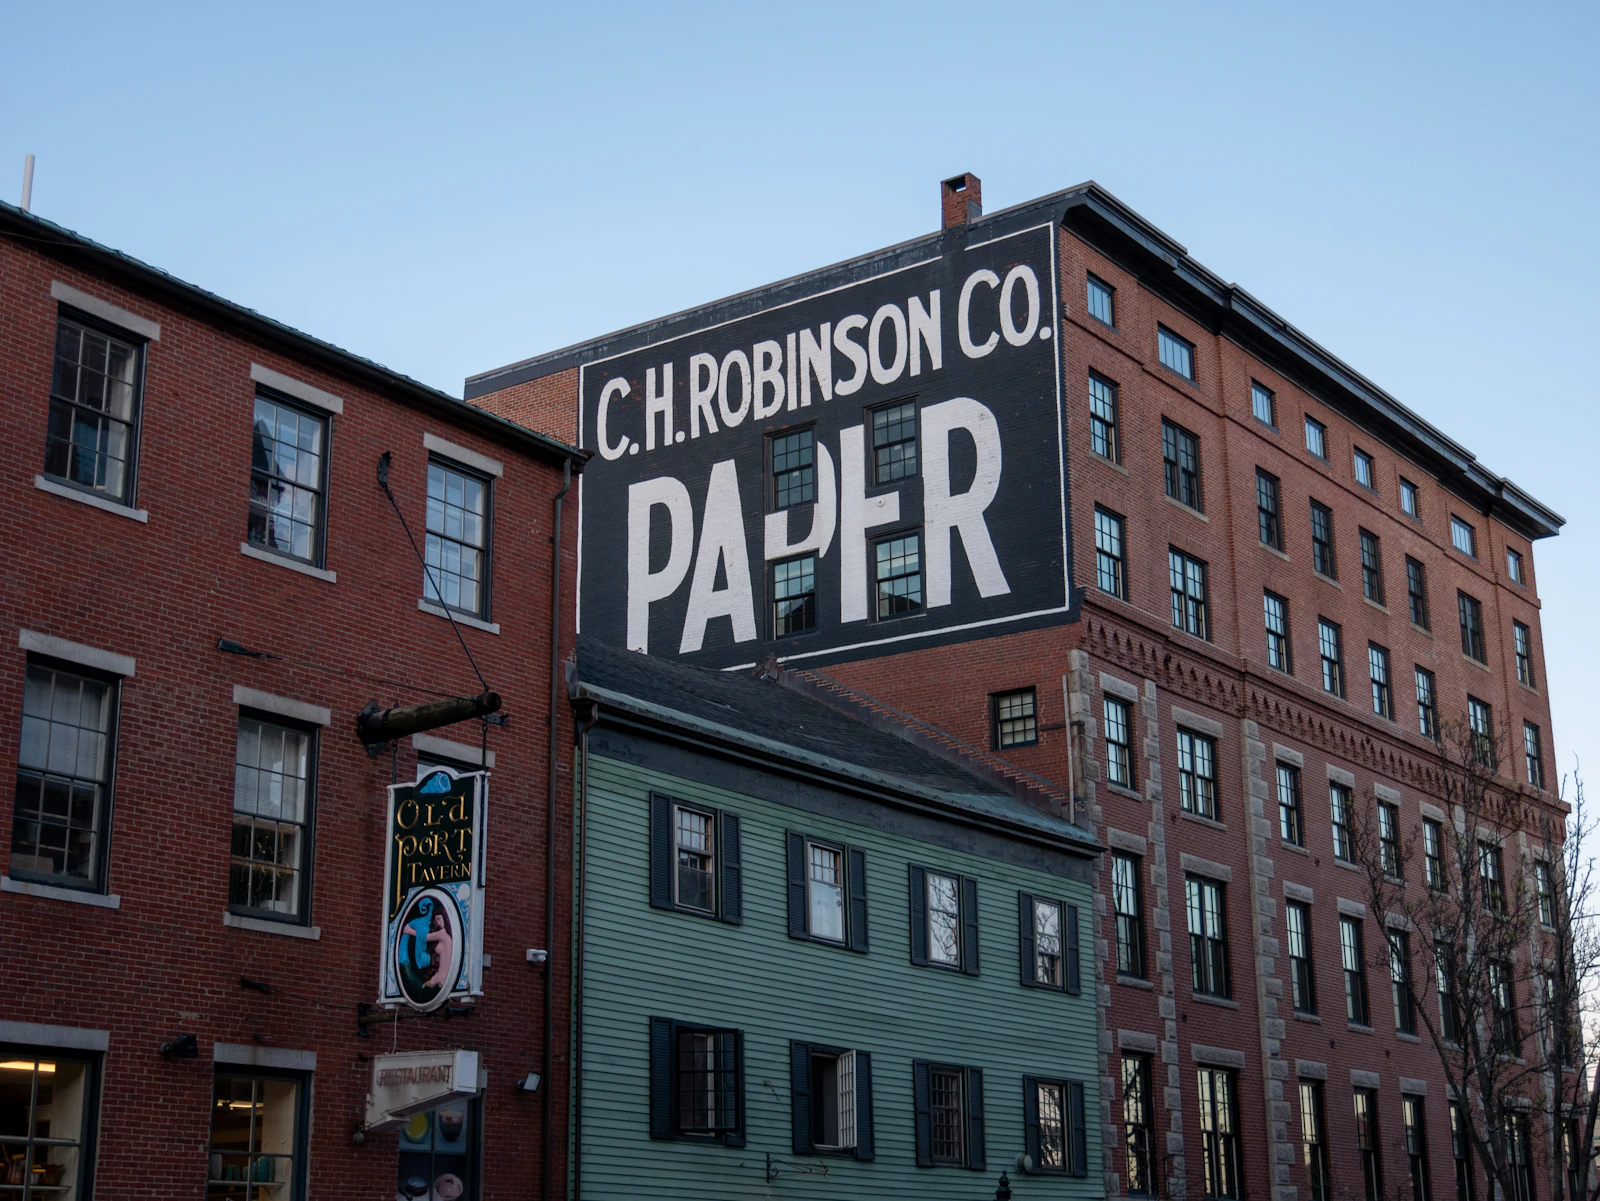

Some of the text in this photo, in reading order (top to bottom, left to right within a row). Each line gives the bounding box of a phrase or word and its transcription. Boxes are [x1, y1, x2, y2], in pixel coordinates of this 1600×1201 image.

[957, 264, 1052, 359] CO.
[406, 861, 471, 884] TAVERN
[378, 1065, 453, 1086] RESTAURANT
